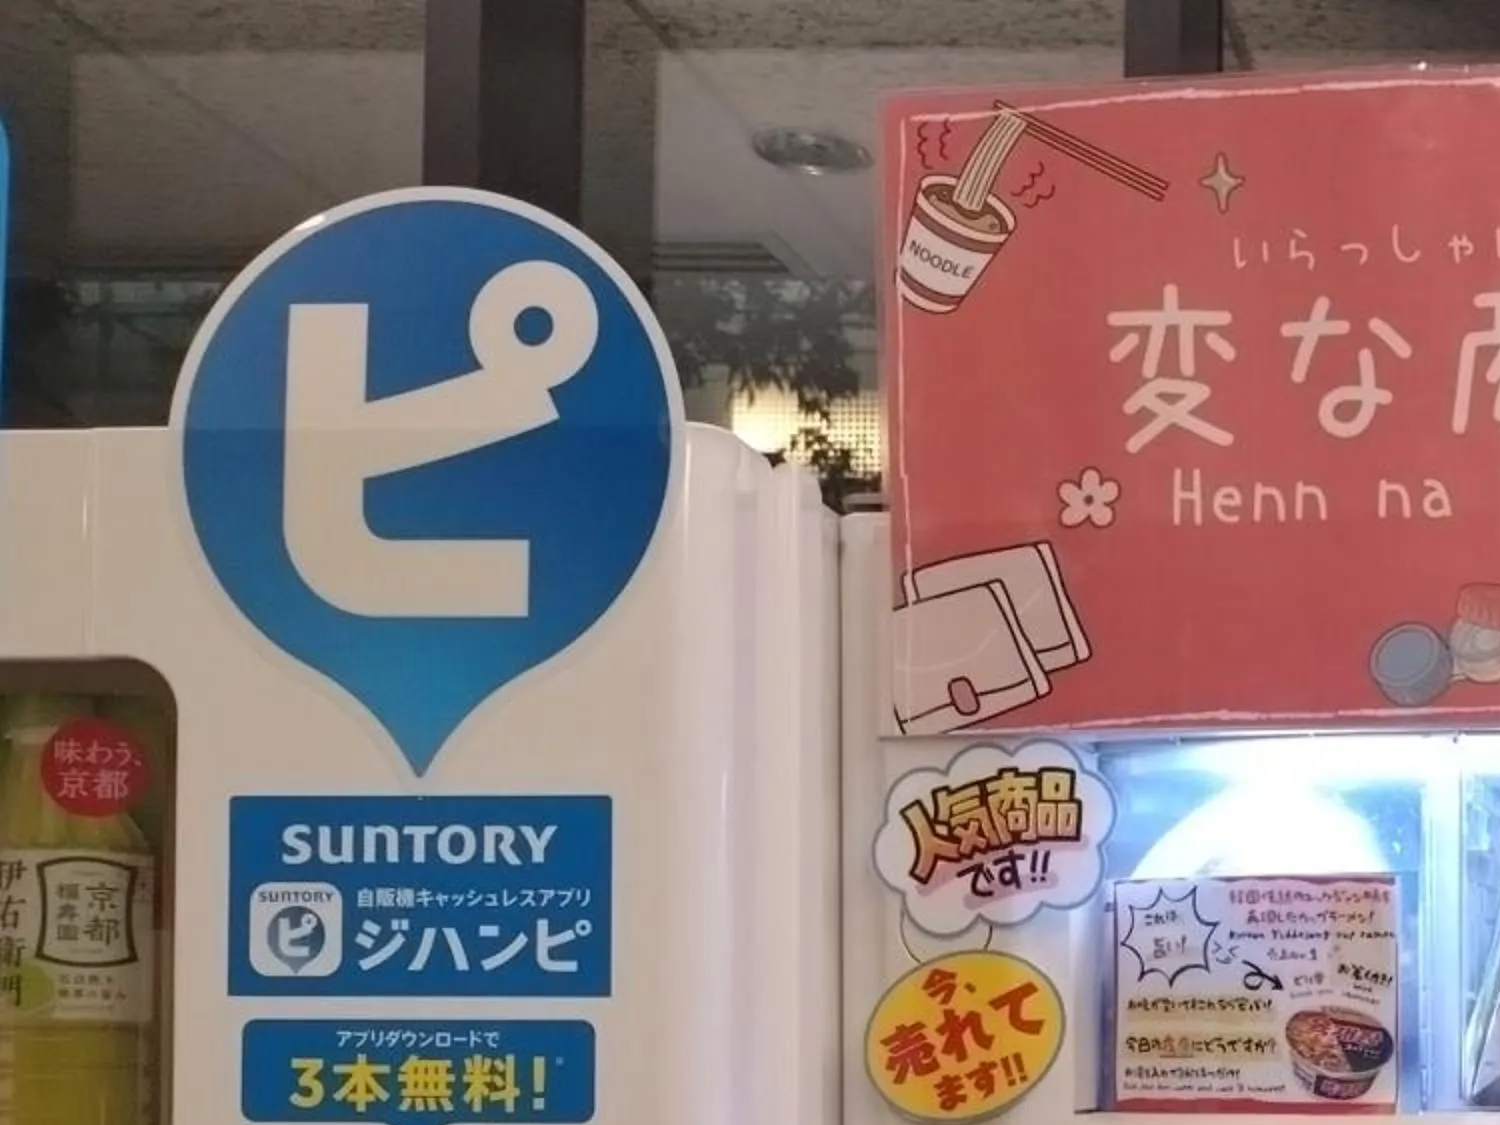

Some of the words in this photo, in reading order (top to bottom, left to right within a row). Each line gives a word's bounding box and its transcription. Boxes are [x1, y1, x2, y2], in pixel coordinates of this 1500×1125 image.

[908, 239, 974, 280] NOODLE
[283, 260, 599, 618] ピ
[1172, 468, 1328, 526] Henn
[1377, 477, 1453, 519] na
[57, 770, 130, 800] 京都
[281, 825, 558, 866] SUNTORY
[899, 766, 1082, 884] 人気商品
[356, 887, 592, 910] 自販機キャッシュレスアプリ
[956, 849, 1050, 898] です!!
[84, 881, 121, 946] 京都
[353, 918, 593, 972] ジハンピ
[336, 1029, 500, 1049] アプリダウンロードで
[879, 980, 1048, 1085] 売れて
[289, 1056, 550, 1113] 3本無料!
[932, 1052, 1029, 1112] ます!!
